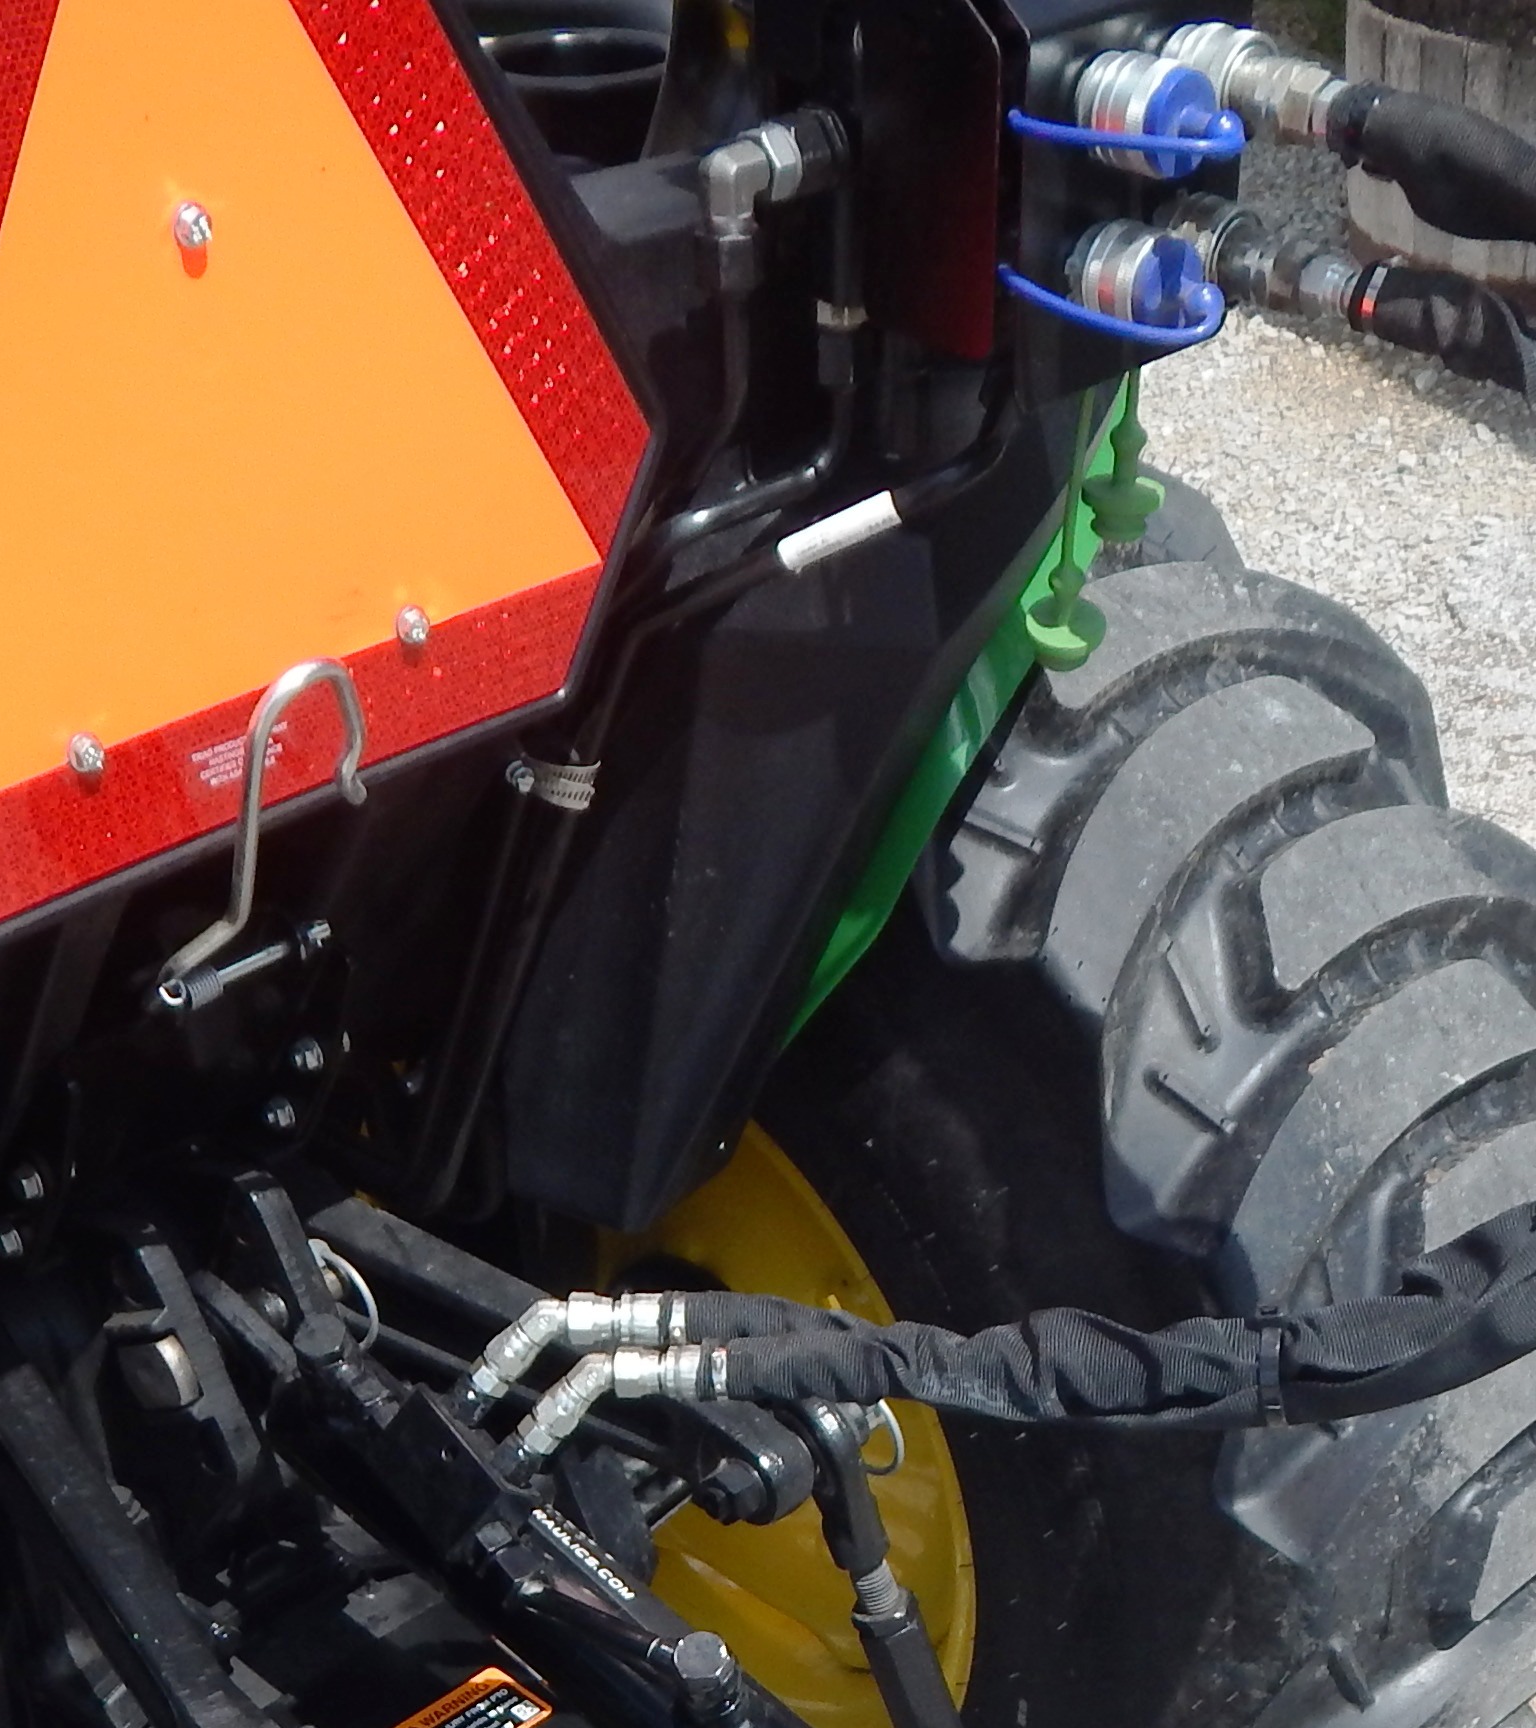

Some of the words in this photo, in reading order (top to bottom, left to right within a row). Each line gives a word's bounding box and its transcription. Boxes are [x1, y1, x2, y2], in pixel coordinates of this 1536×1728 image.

[532, 1508, 635, 1600] RAULICS.COM
[423, 1682, 490, 1726] WARNING
[490, 1688, 508, 1702] PTO
